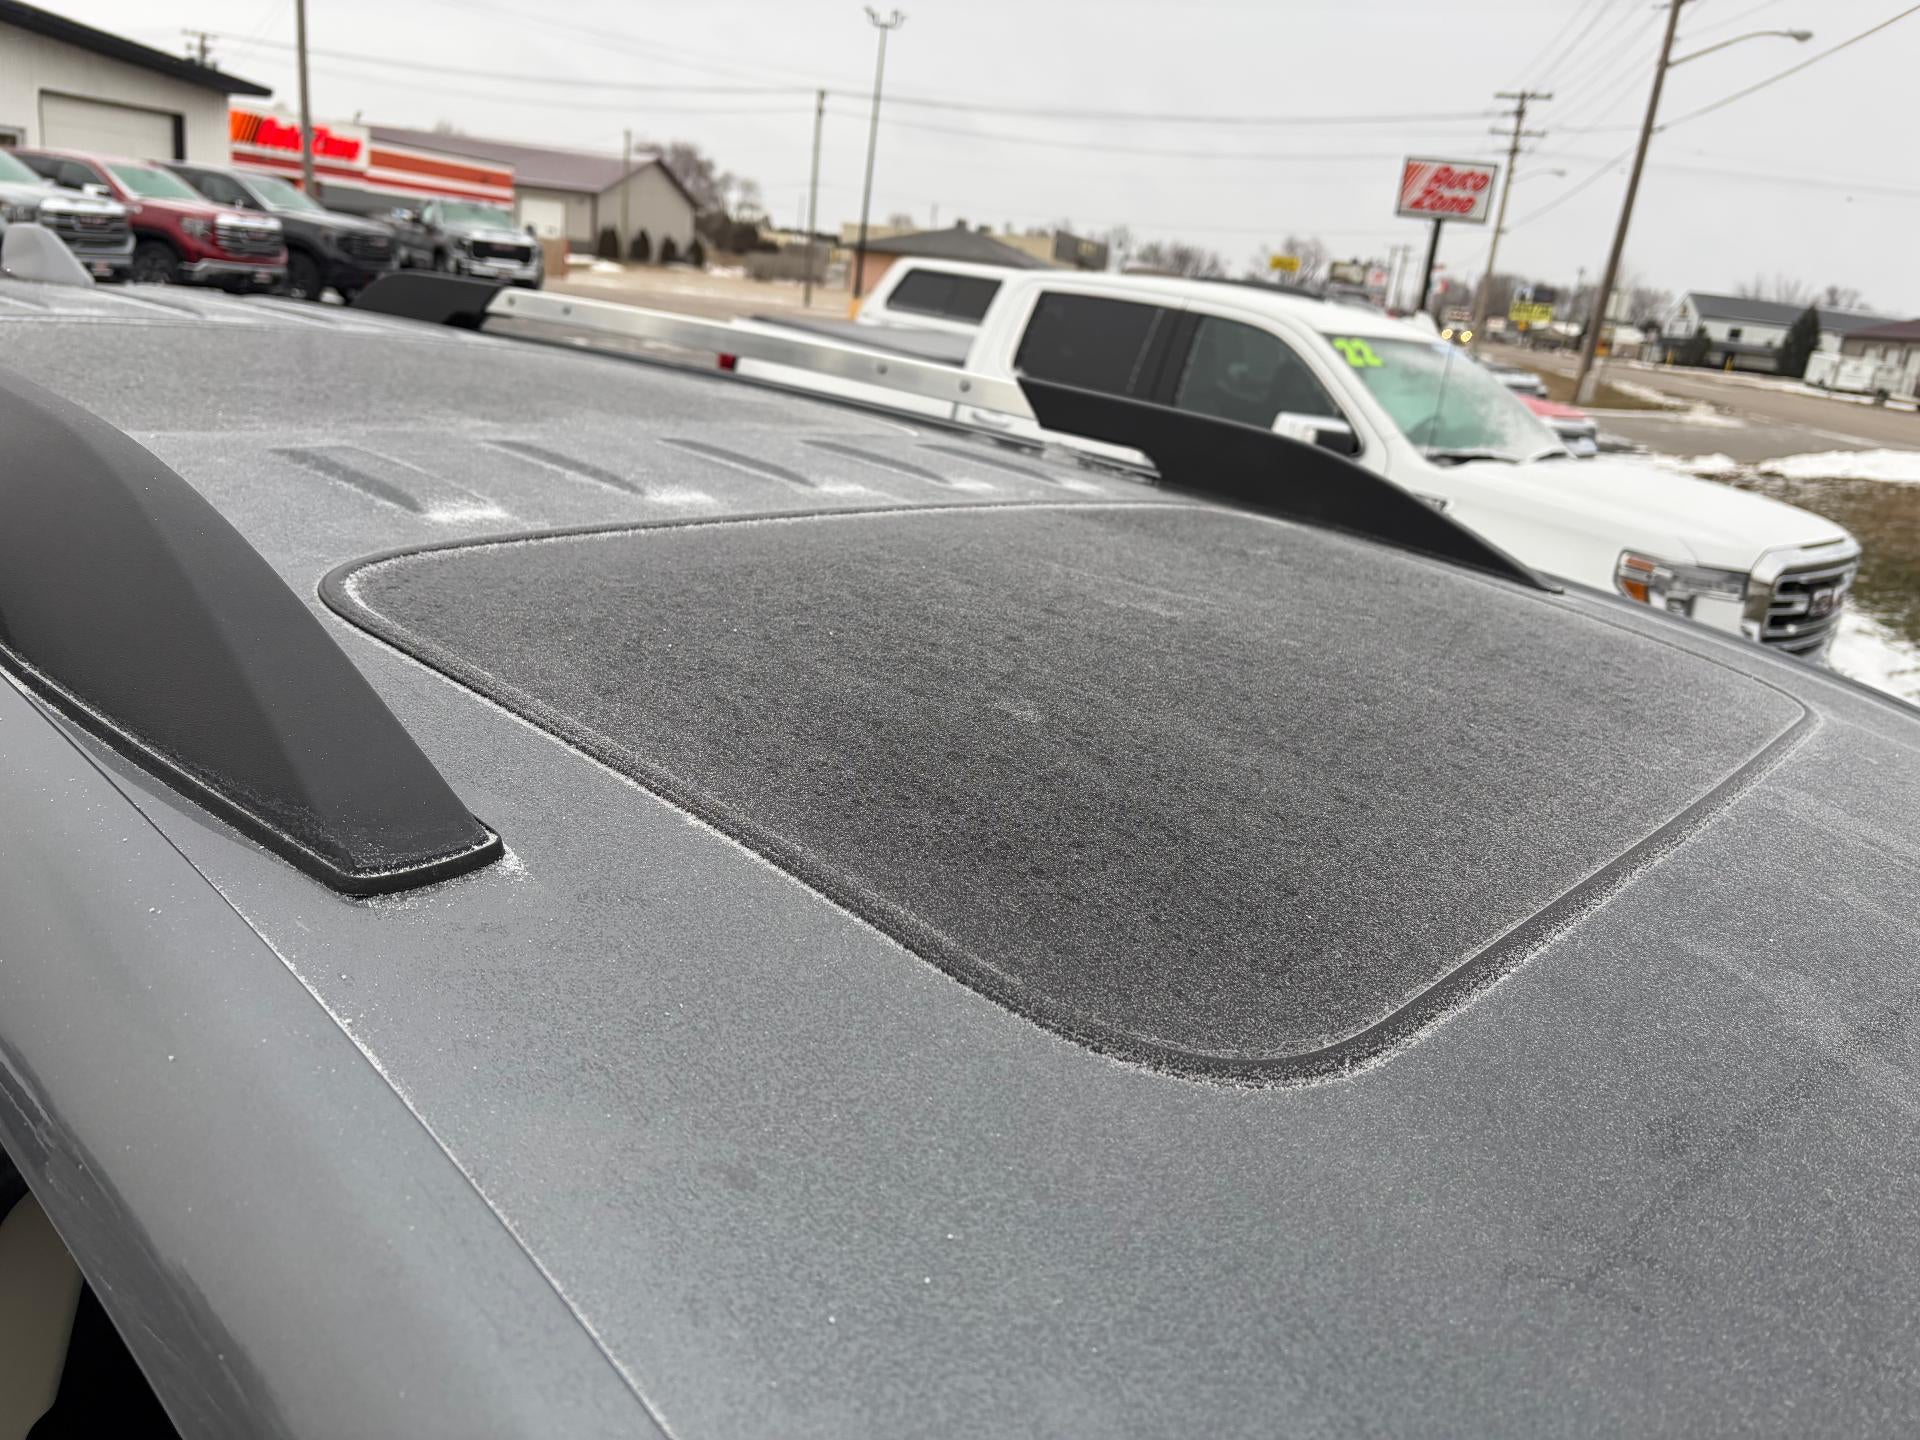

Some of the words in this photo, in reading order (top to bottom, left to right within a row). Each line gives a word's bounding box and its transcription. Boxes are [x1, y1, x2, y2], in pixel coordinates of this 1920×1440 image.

[1430, 166, 1489, 191] Auto
[1410, 188, 1476, 213] Zone
[1332, 337, 1383, 367] 22
